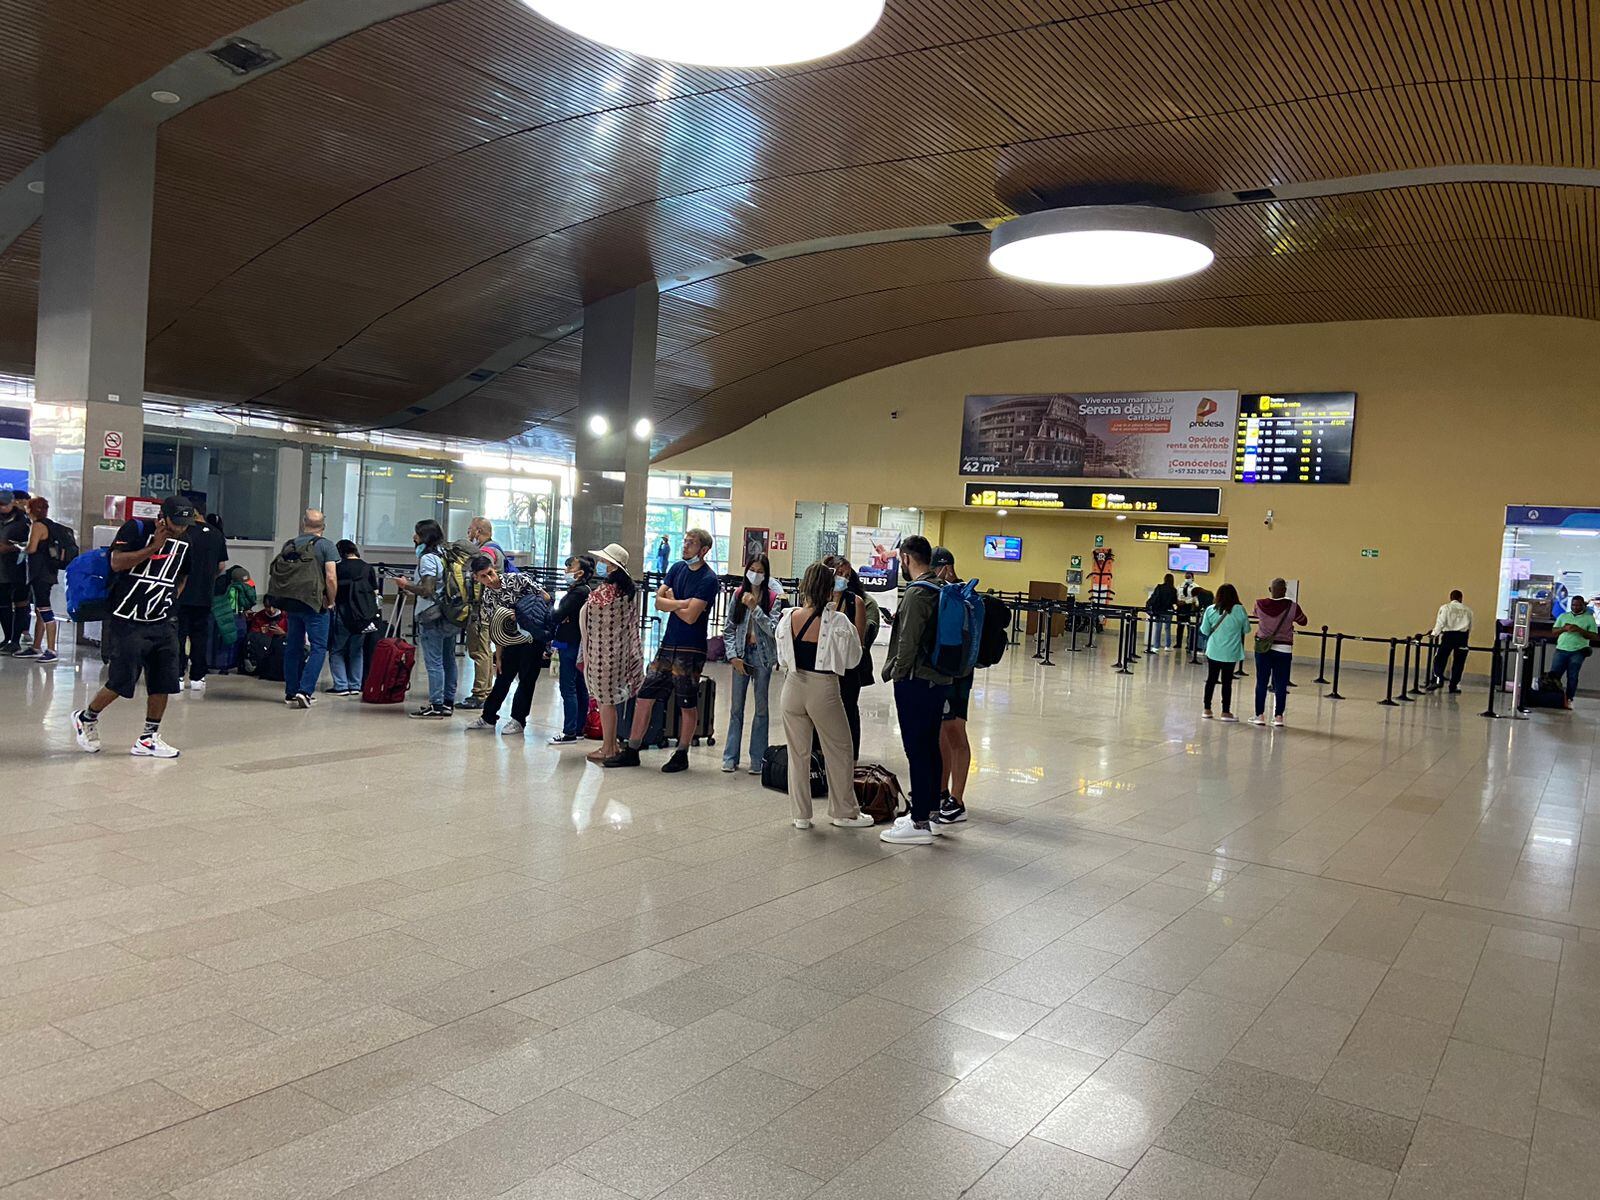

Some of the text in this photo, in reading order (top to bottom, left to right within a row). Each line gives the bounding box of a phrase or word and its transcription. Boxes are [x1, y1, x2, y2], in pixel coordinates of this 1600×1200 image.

[1079, 403, 1173, 415] Serena del Mar
[1128, 414, 1171, 422] Cartagena
[1189, 420, 1224, 428] prodesa
[1188, 435, 1217, 443] Opción
[963, 461, 980, 472] 42
[1169, 459, 1228, 468] ¡Conócelos!
[140, 473, 191, 490] etBlue
[1107, 501, 1133, 510] Puertas
[1147, 502, 1158, 510] 15
